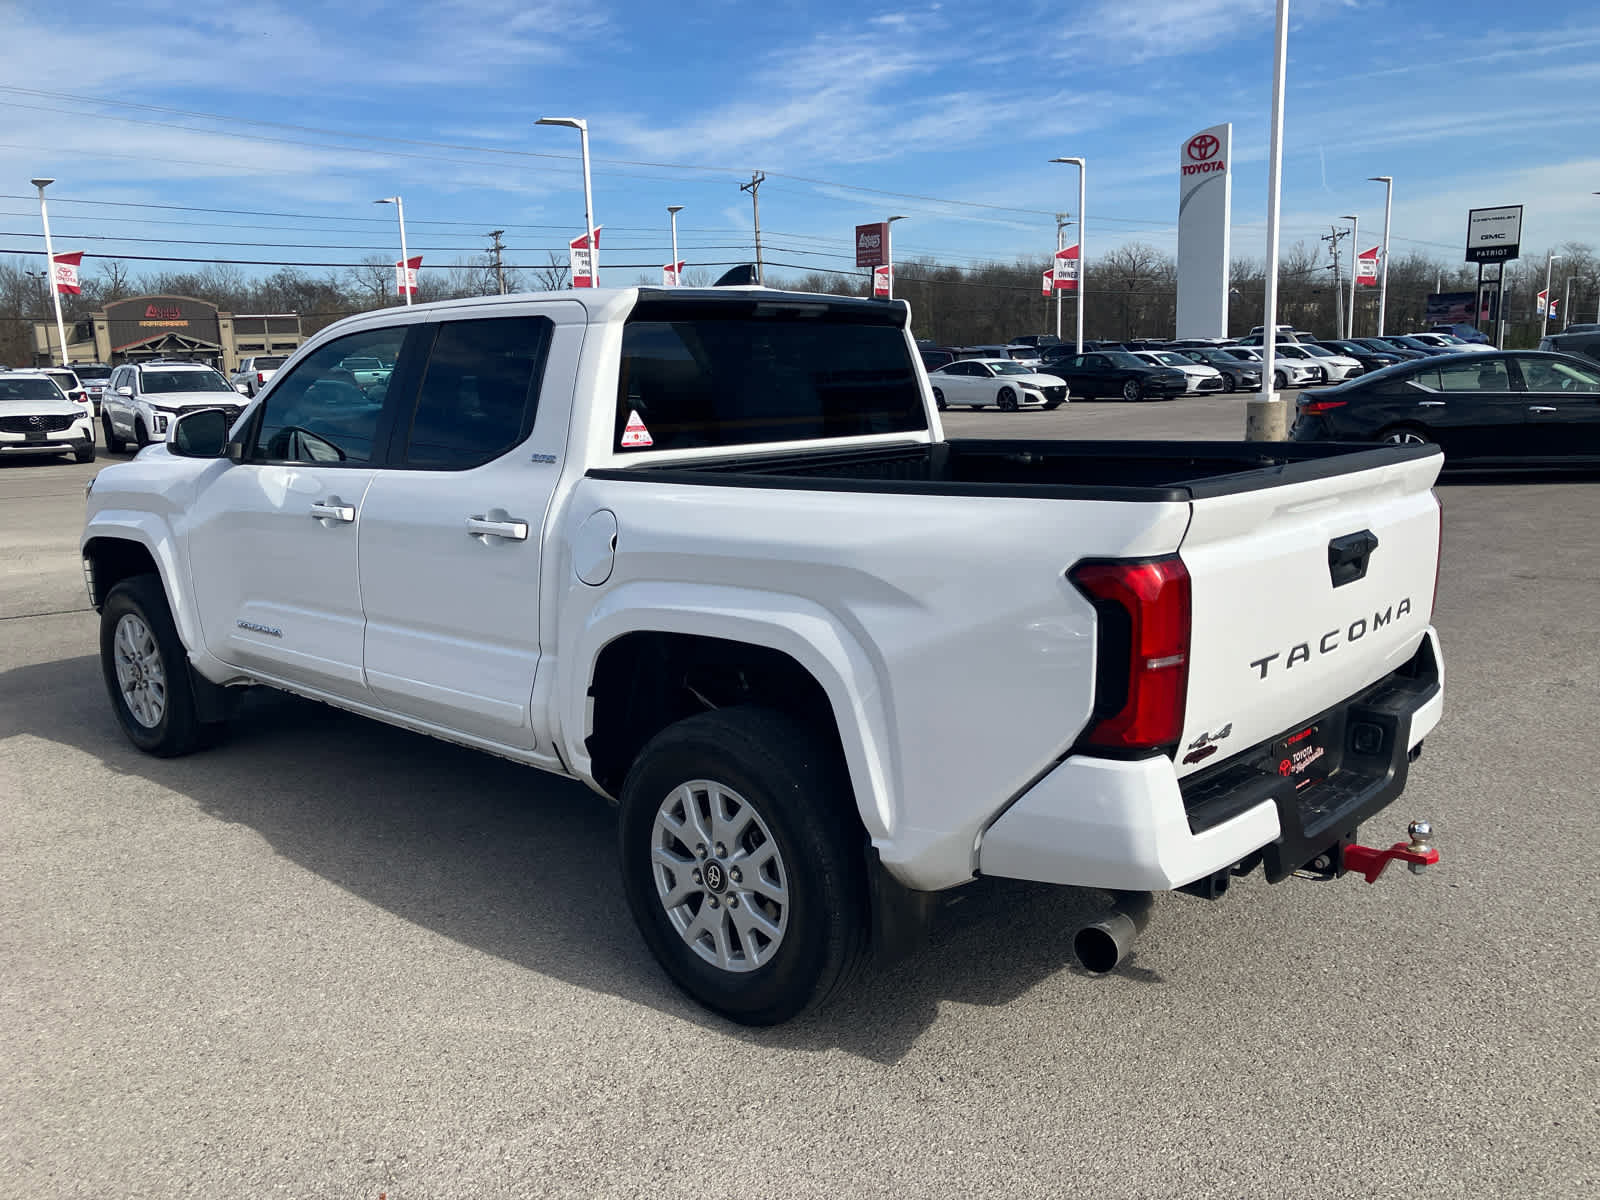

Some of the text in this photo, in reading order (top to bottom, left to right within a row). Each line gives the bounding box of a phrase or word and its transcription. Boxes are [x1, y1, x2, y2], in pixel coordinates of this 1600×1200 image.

[1181, 160, 1225, 176] TOYOTA
[1476, 248, 1508, 257] PATRIOT
[1249, 597, 1412, 680] TACOMA
[1293, 744, 1313, 763] TOYOTA
